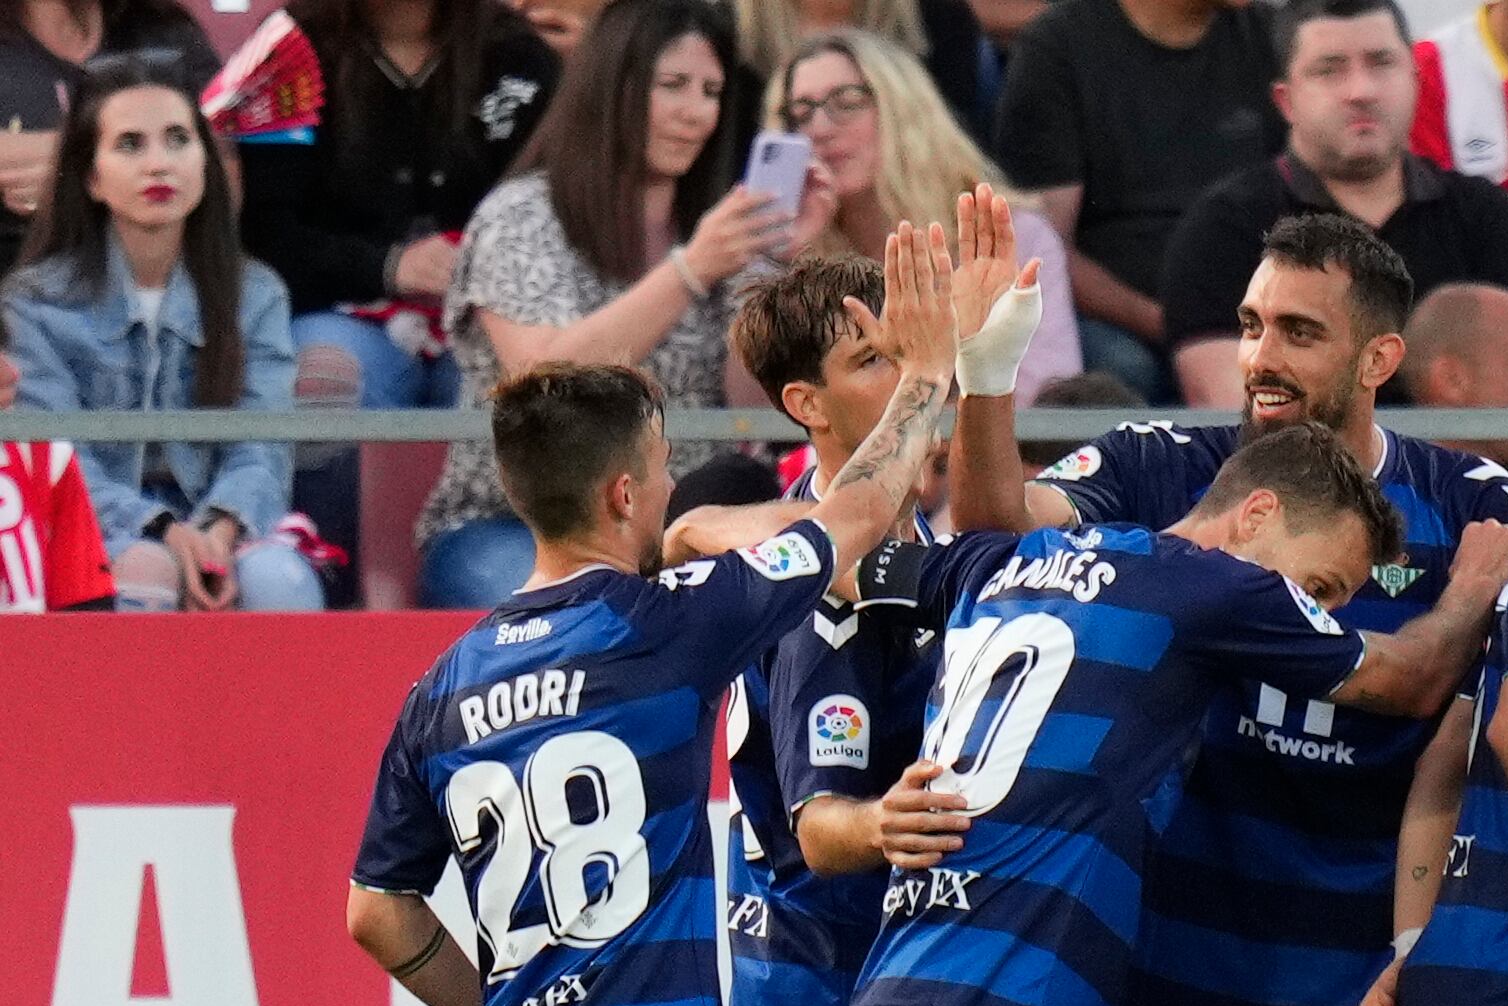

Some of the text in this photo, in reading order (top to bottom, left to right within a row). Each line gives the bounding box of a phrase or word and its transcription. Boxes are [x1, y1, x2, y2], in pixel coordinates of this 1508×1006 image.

[459, 669, 586, 745] RODRI
[816, 744, 863, 758] LaLiga
[1238, 714, 1356, 766] ntwork
[444, 730, 651, 985] 28
